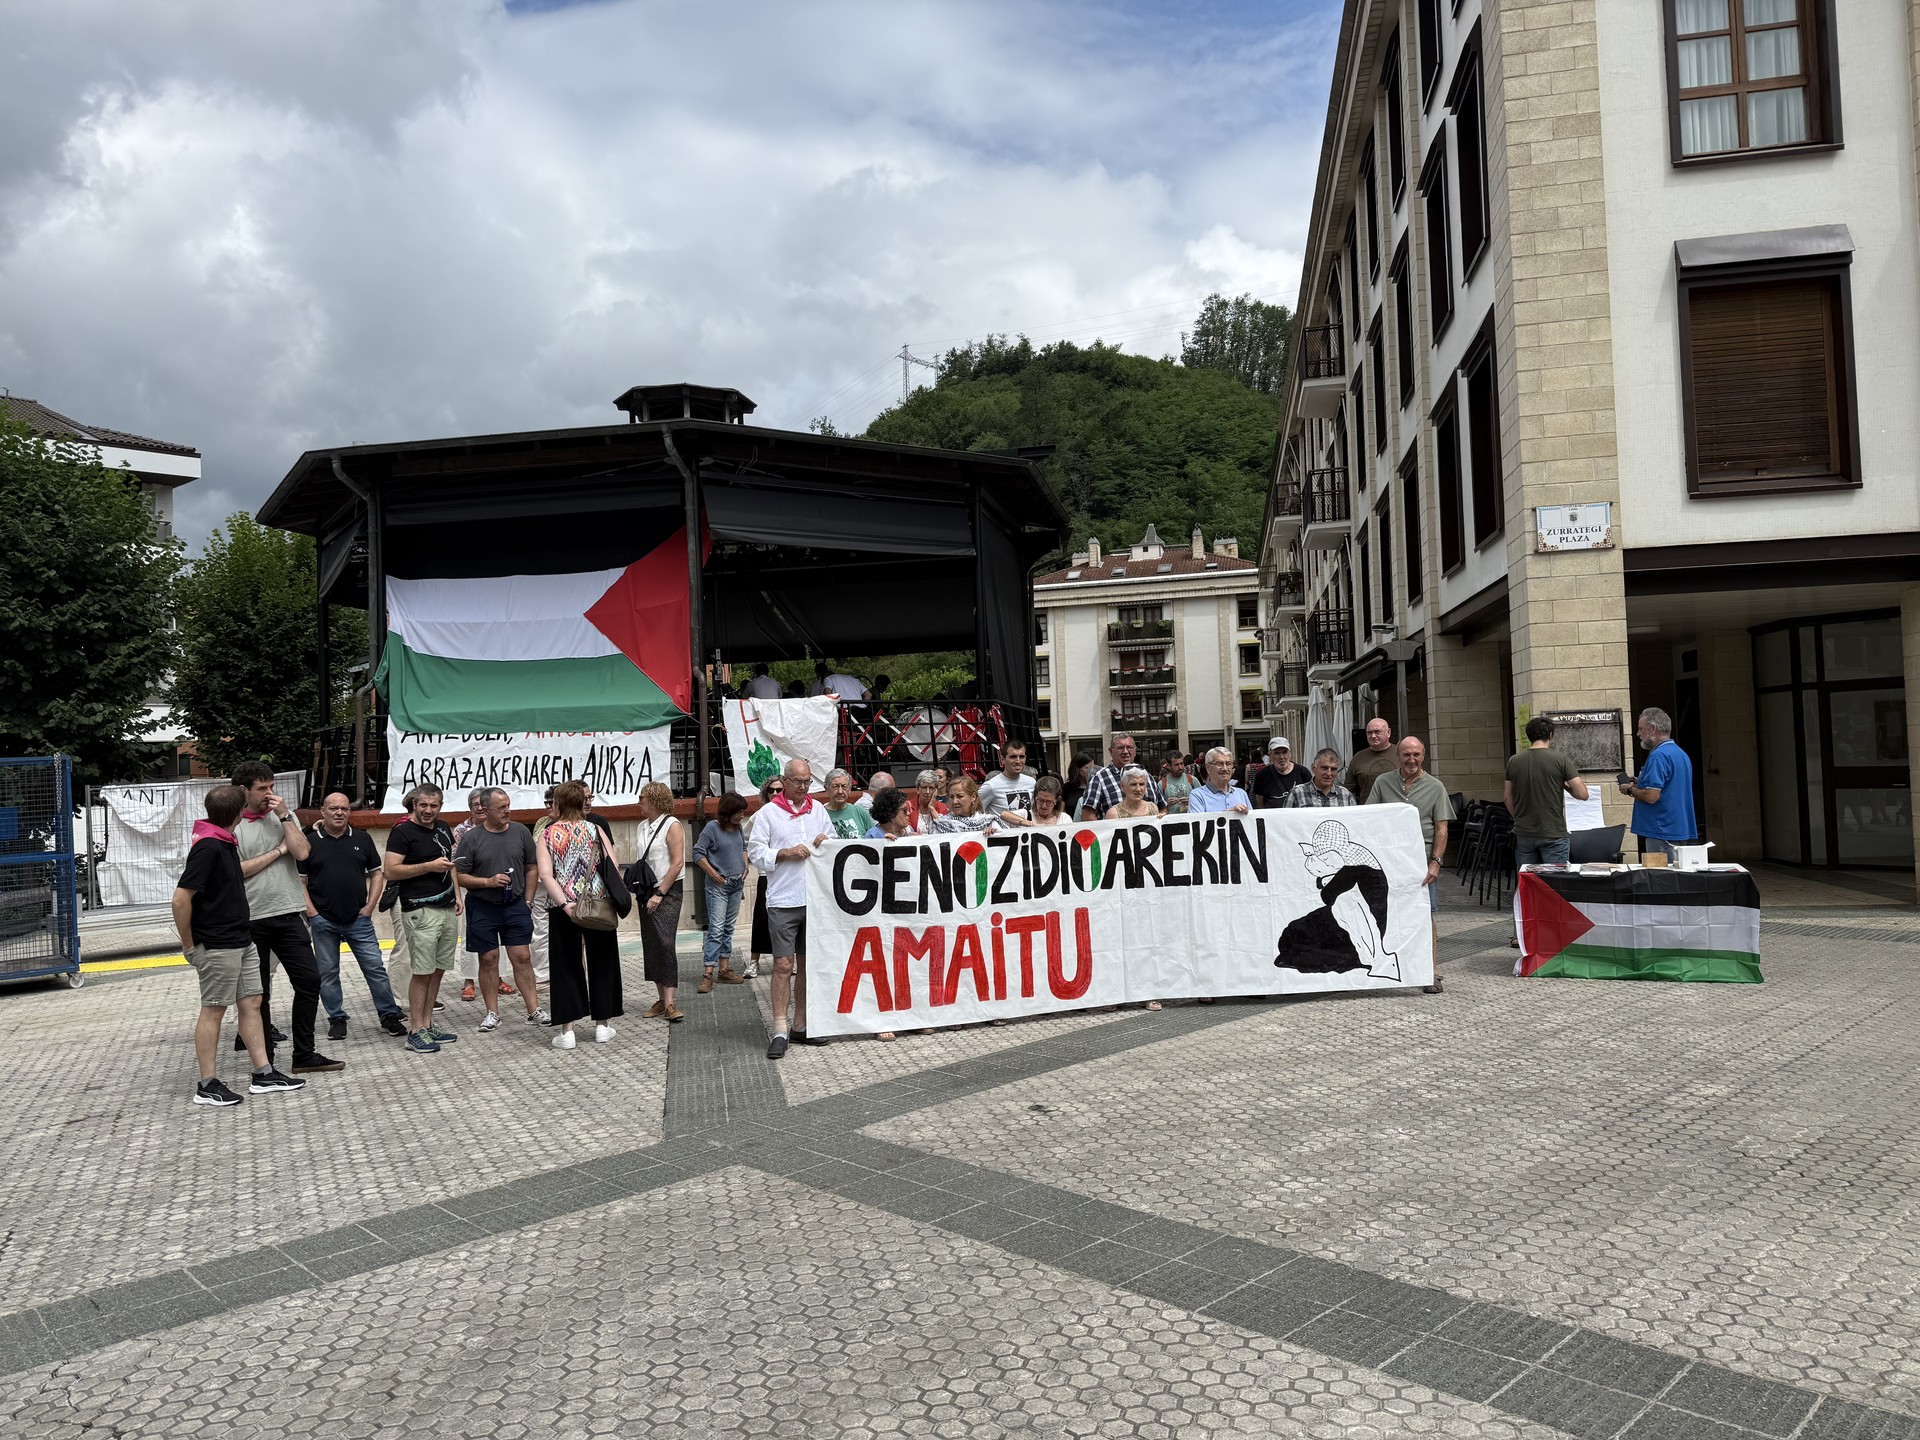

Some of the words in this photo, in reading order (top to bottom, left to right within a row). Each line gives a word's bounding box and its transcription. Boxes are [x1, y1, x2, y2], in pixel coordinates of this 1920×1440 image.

[1546, 525, 1602, 536] ZURRATEGI
[1559, 535, 1590, 543] PLAZA
[402, 754, 573, 794] ARRAZAKERIAREN
[580, 743, 653, 795] AURKA
